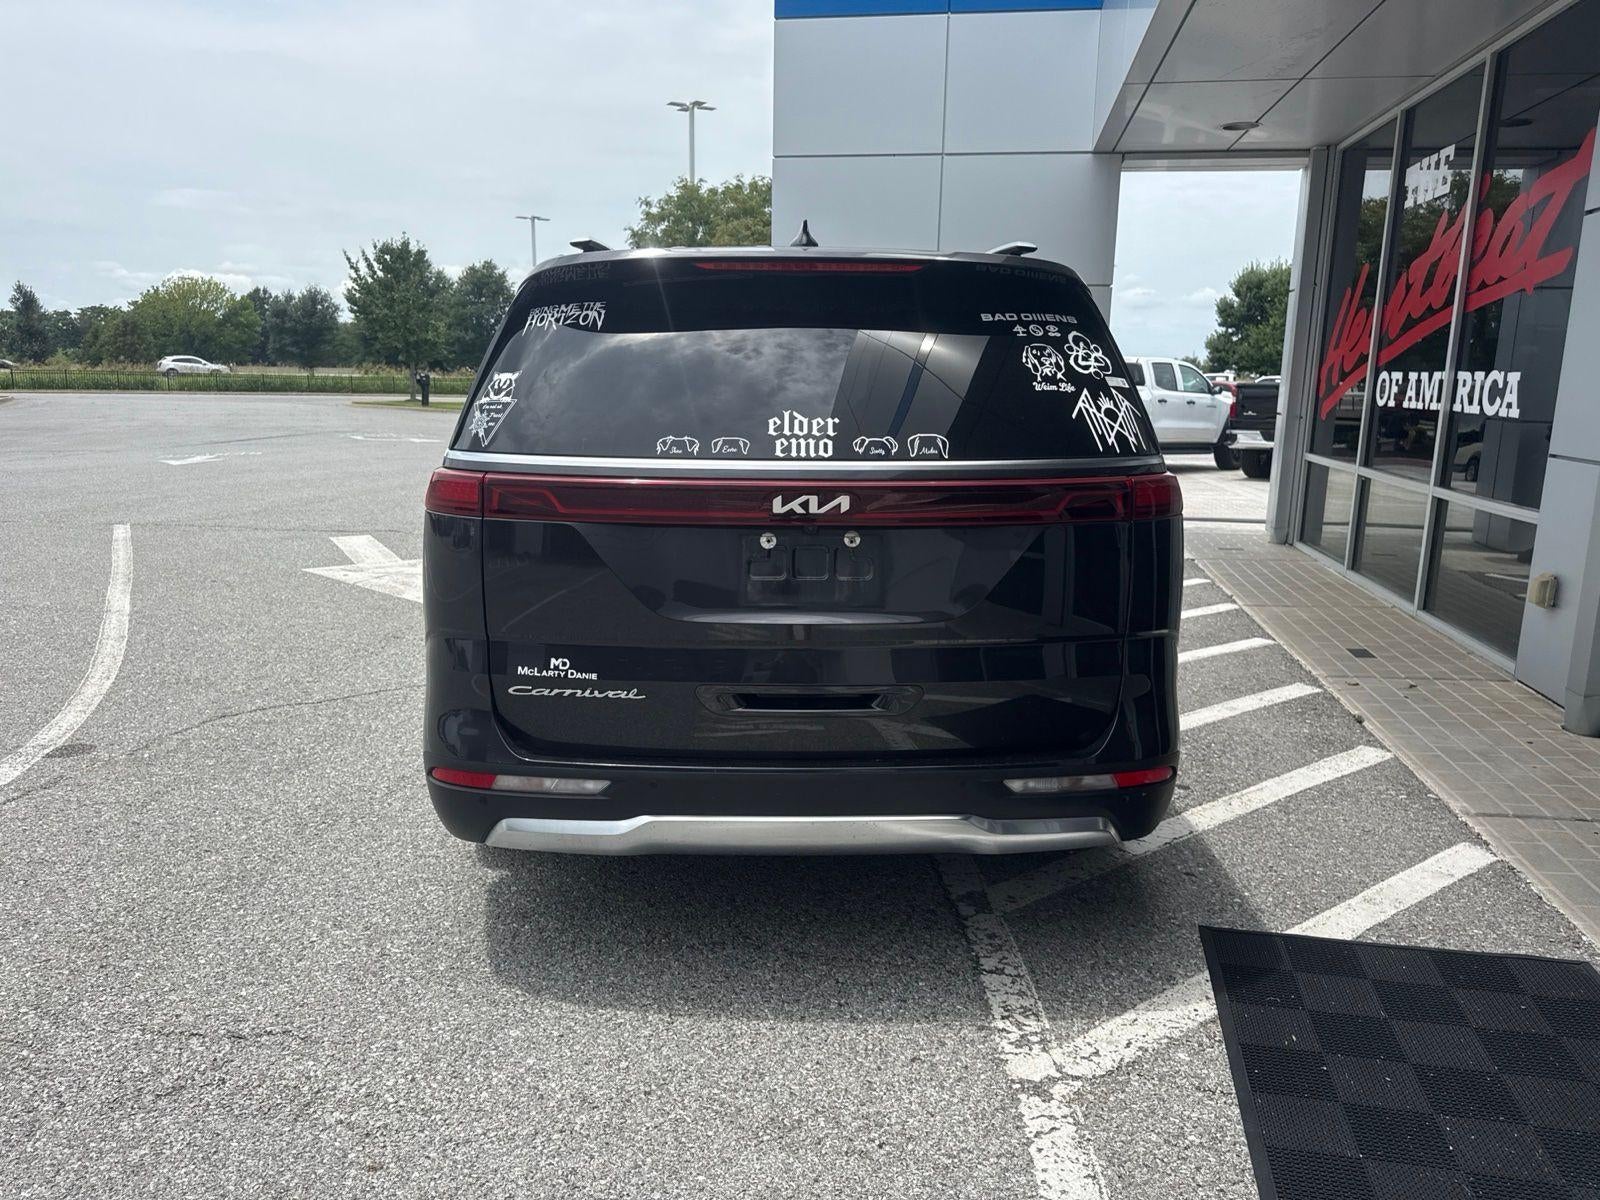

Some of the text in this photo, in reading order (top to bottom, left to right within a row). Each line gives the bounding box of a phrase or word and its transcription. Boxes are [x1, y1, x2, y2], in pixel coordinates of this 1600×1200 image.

[1404, 144, 1456, 209] THE
[980, 313, 1019, 322] BAD
[1032, 382, 1077, 393] Weim Life
[1375, 369, 1522, 419] OF AMRICA
[767, 409, 840, 437] elder
[774, 437, 834, 458] emo
[772, 495, 850, 514] KIA
[507, 685, 646, 700] Carnival
